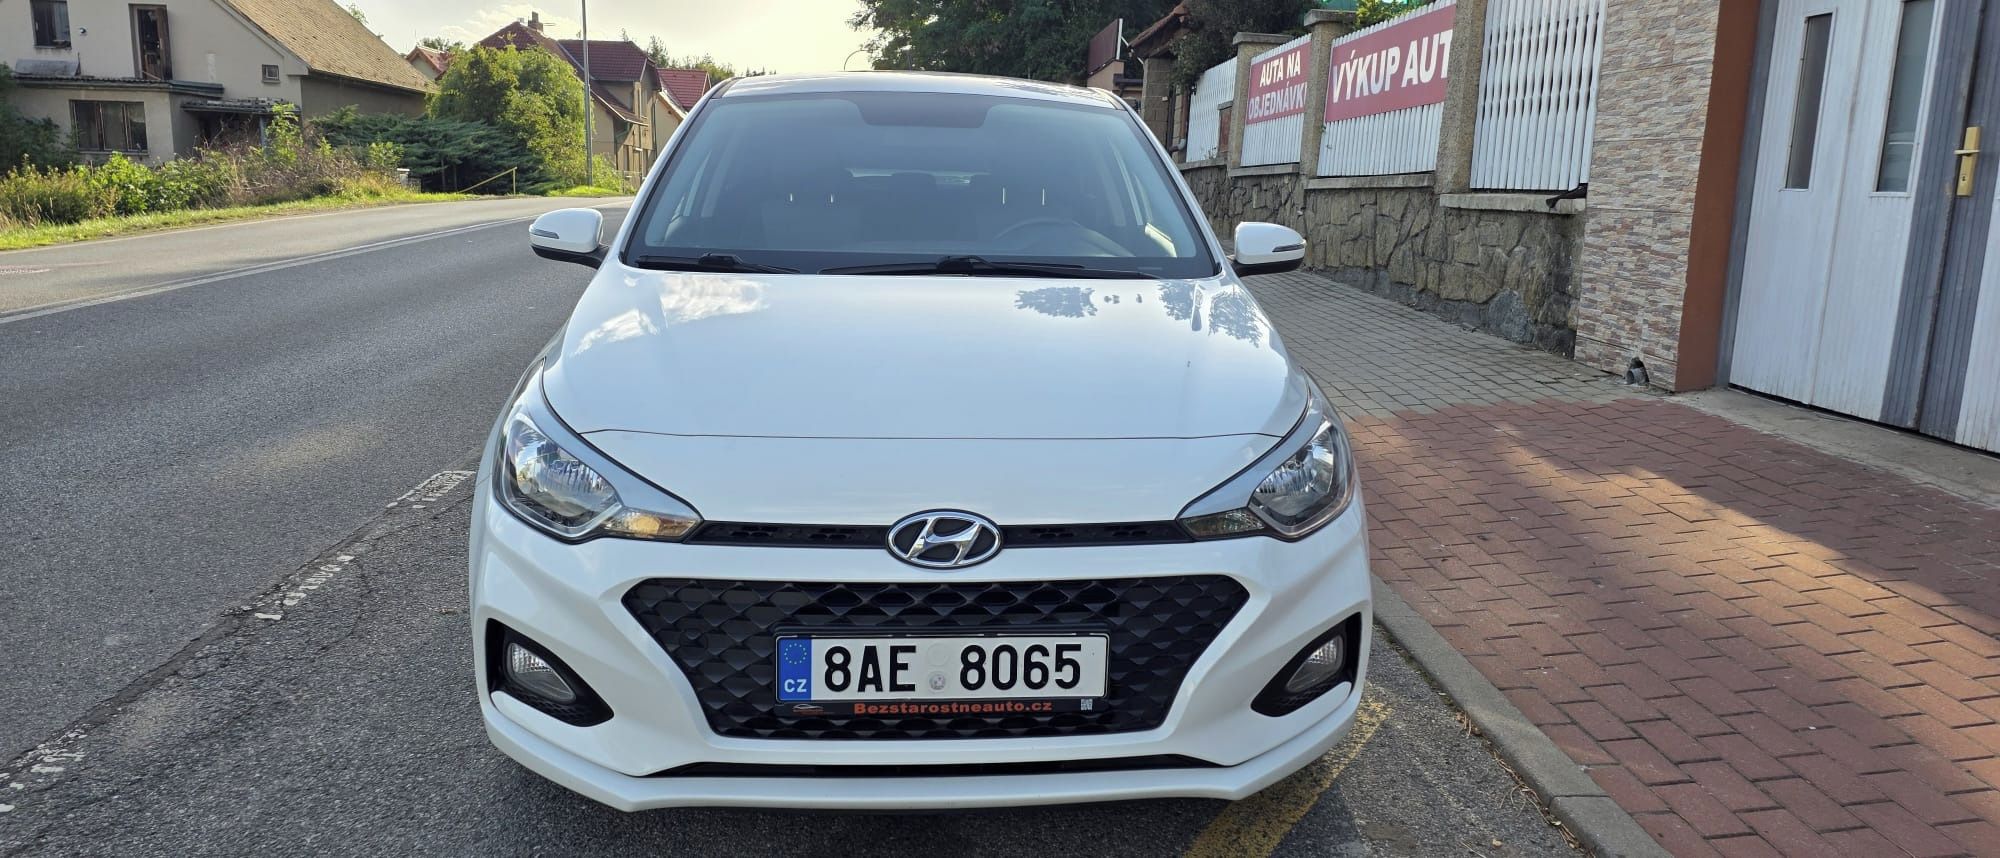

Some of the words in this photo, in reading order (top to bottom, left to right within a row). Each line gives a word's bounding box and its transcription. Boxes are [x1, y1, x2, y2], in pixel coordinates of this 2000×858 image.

[1260, 57, 1283, 87] AUTA
[1287, 51, 1300, 78] NA
[1332, 49, 1400, 103] VÝKUP
[1401, 29, 1453, 87] AUT
[784, 678, 807, 692] CZ
[824, 645, 916, 692] 8AE
[960, 643, 1081, 691] 8065
[854, 700, 1052, 715] Bezstarostneauto.cz
